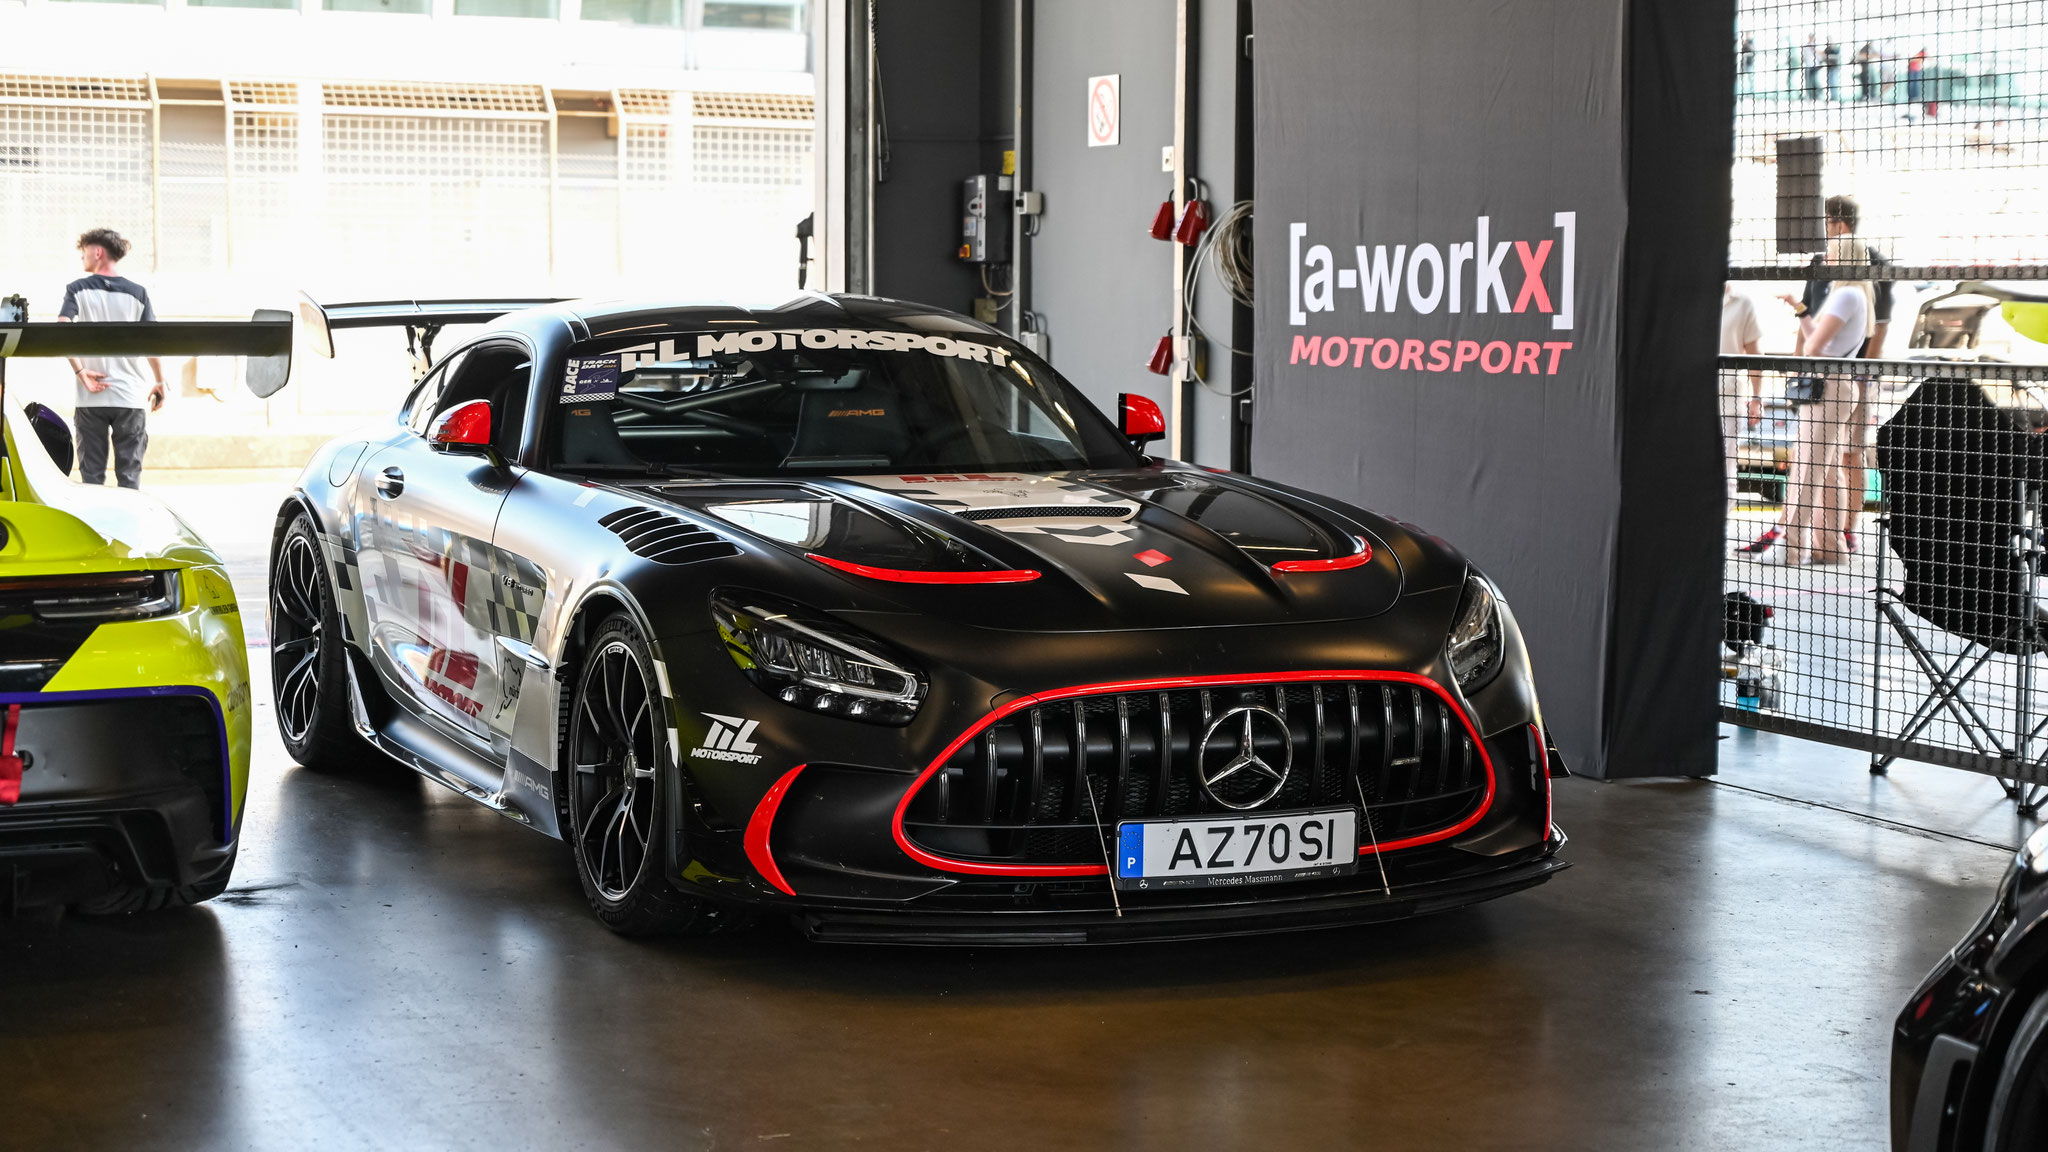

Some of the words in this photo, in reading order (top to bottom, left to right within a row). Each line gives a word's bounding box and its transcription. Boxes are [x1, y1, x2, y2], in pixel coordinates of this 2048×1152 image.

[1289, 210, 1577, 331] [a-workx]
[697, 328, 1012, 368] MOTORSPORT
[1289, 334, 1574, 376] MOTORSPORT
[563, 359, 580, 394] RACE
[847, 408, 886, 417] AMG
[690, 747, 763, 765] MOTORSPORT
[523, 776, 550, 801] AMG
[1167, 826, 1236, 871] AZ
[1242, 823, 1292, 867] 70
[1126, 856, 1137, 870] P
[1206, 875, 1243, 887] Mercedes
[1244, 873, 1284, 884] Massmann
